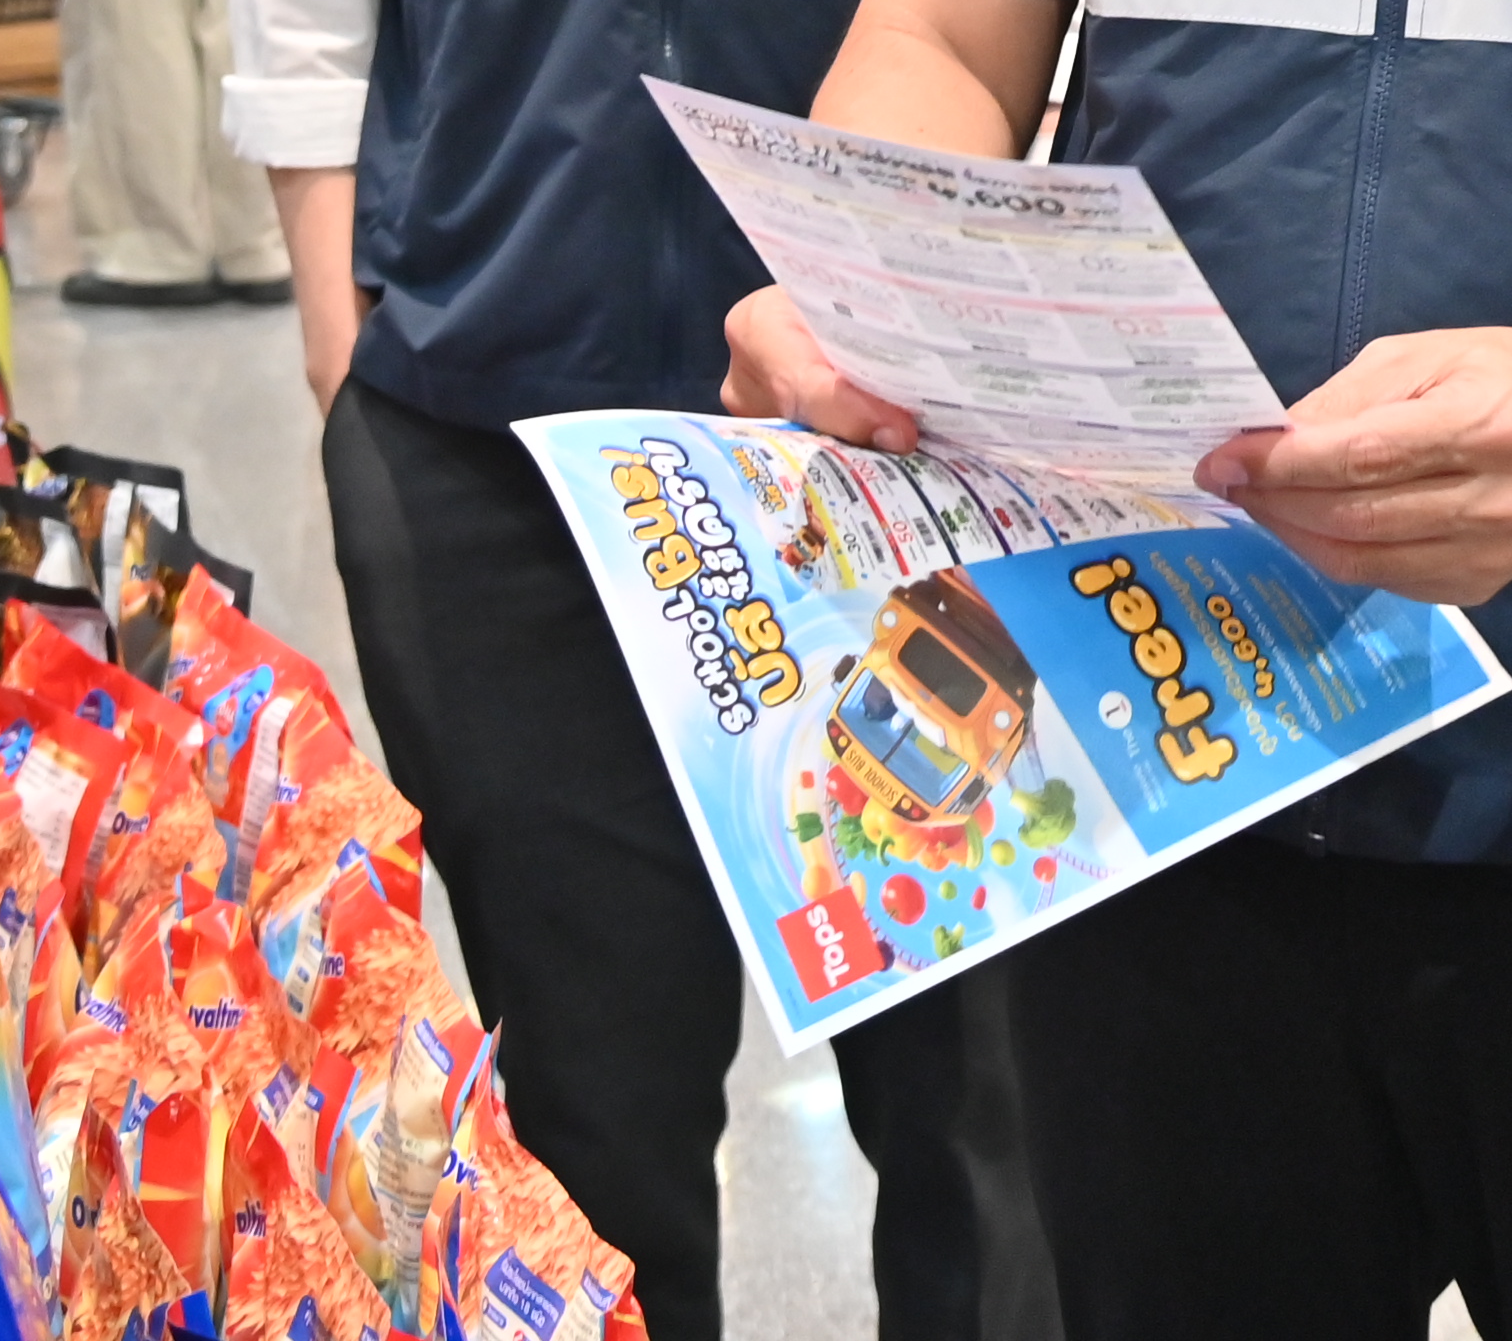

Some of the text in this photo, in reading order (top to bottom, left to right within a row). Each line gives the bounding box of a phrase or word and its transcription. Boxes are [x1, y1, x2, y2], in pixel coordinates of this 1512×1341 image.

[663, 588, 754, 734] SCHOOL
[1073, 561, 1239, 785] Free!
[1205, 591, 1275, 700] 4,600
[844, 749, 899, 802] SCHOOL BUS
[805, 903, 851, 987] Tops
